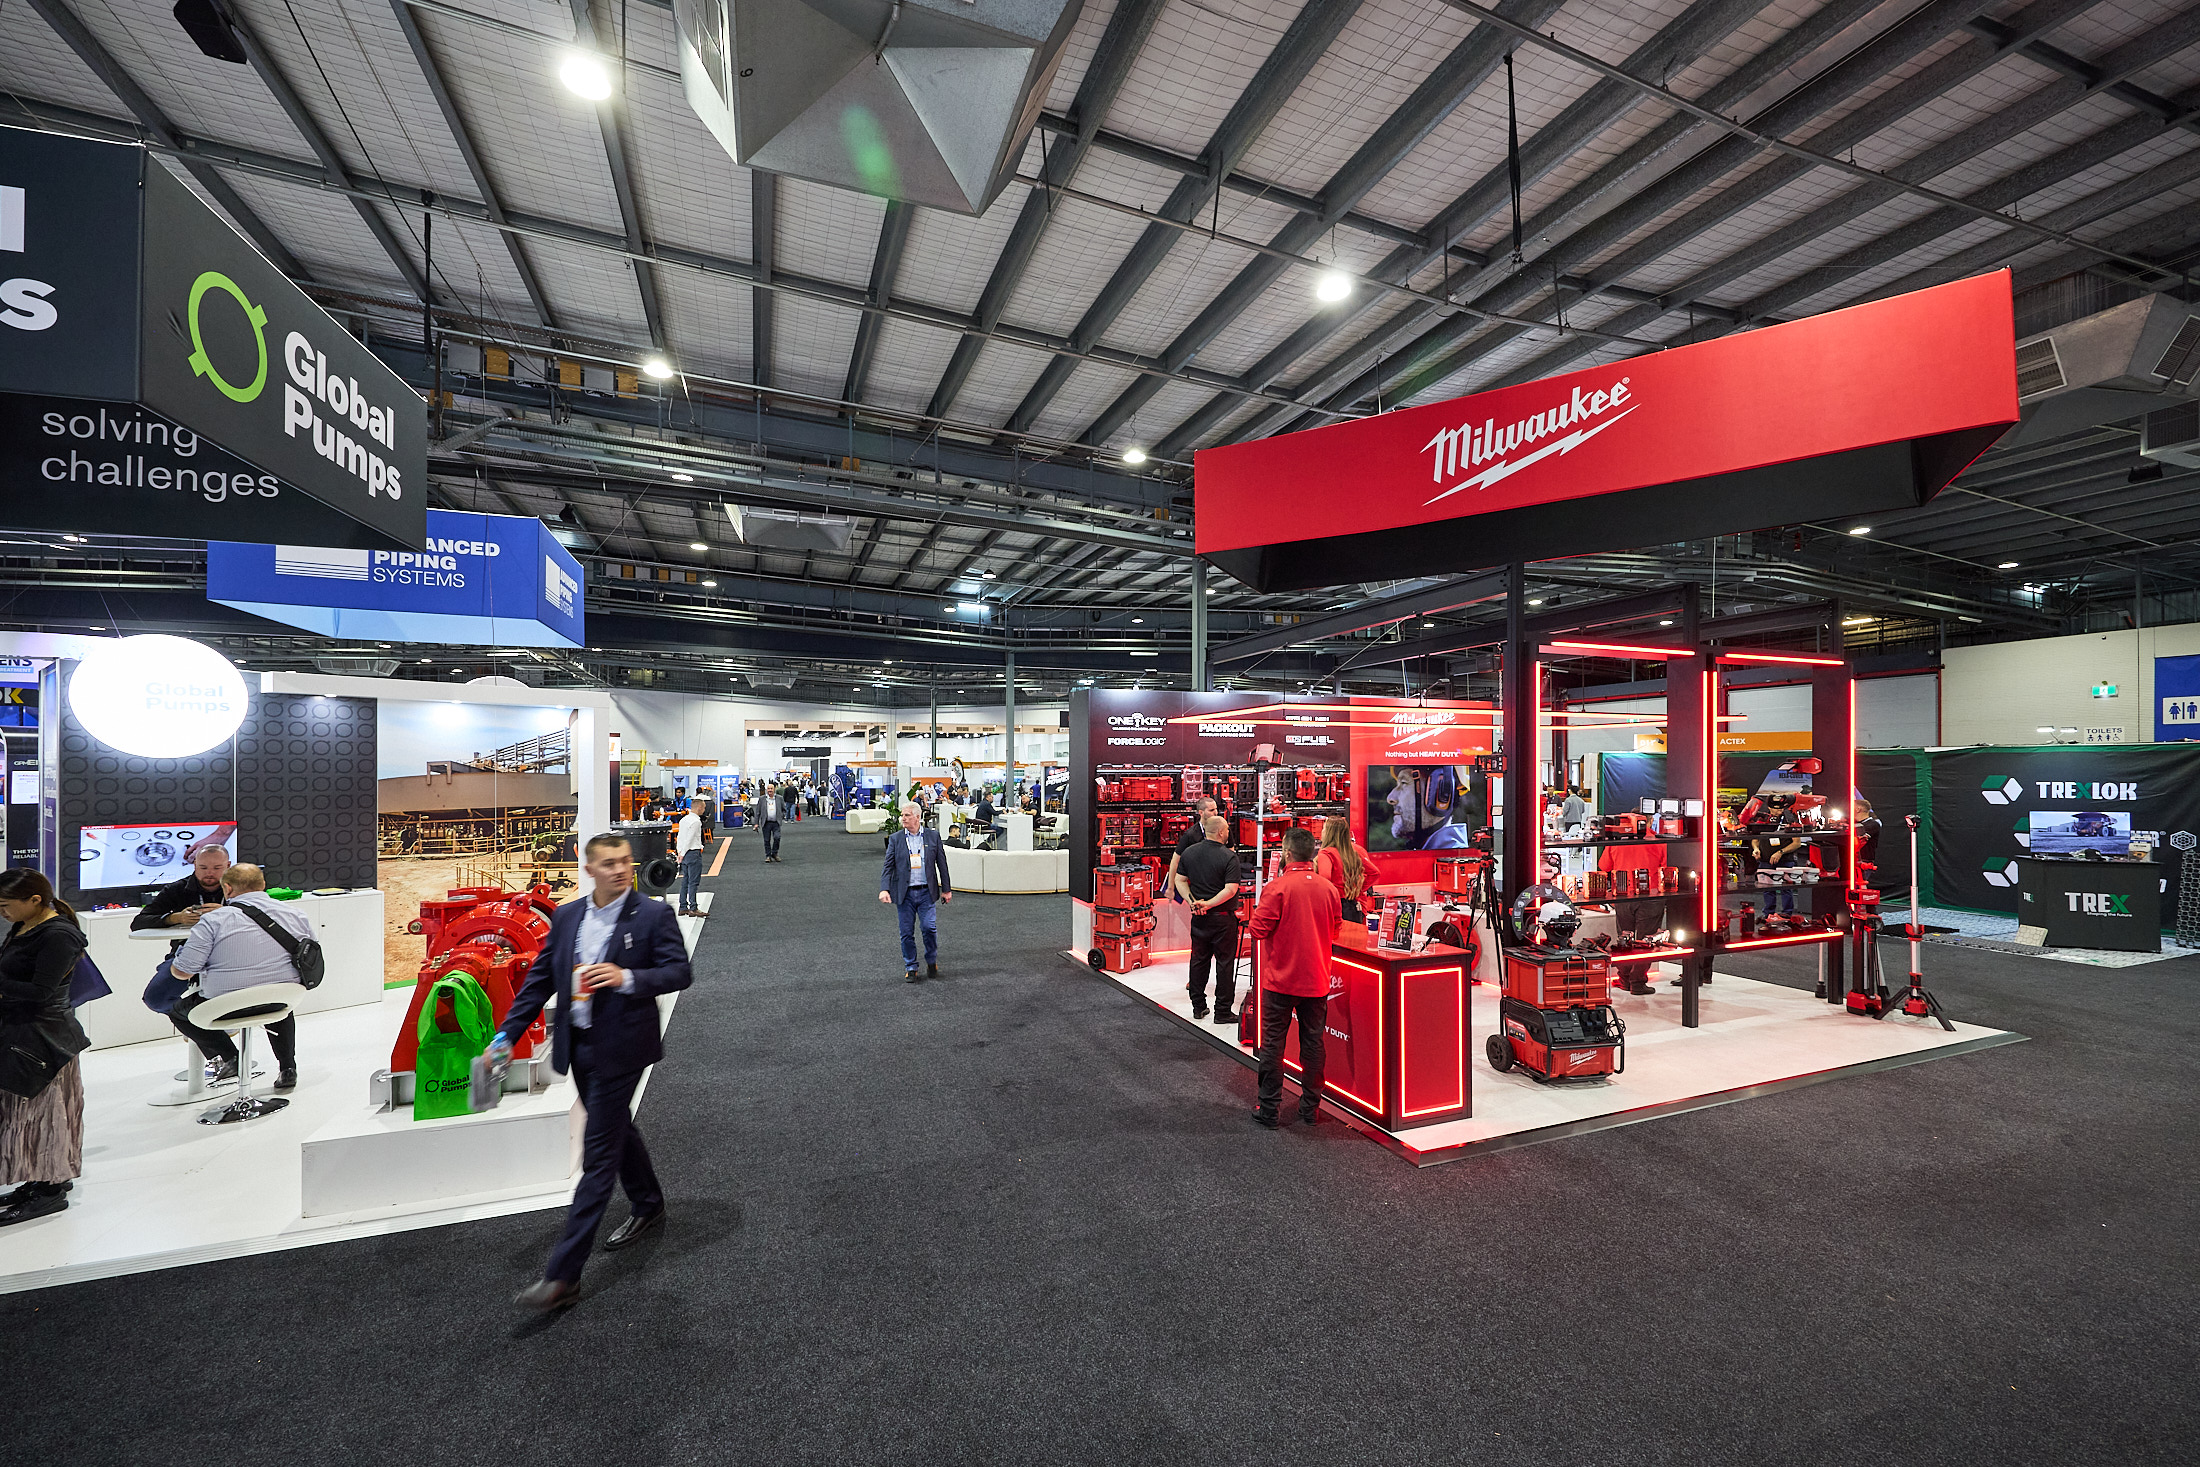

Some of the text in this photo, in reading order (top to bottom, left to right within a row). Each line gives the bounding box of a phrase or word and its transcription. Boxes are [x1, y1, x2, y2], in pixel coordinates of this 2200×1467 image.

[284, 331, 395, 450] Global
[42, 407, 200, 457] solving
[284, 382, 402, 501] Pumps
[40, 449, 280, 503] challenges
[426, 538, 500, 557] ANCED
[374, 550, 457, 571] PIPING
[372, 567, 466, 588] SYSTEMS
[145, 682, 223, 697] Global
[145, 697, 231, 714] Pumps
[1198, 723, 1256, 733] PACKOUT
[1385, 751, 1408, 759] Nothing
[2036, 781, 2138, 800] TREXLOK
[2064, 892, 2131, 914] TREX
[441, 1074, 470, 1087] Global
